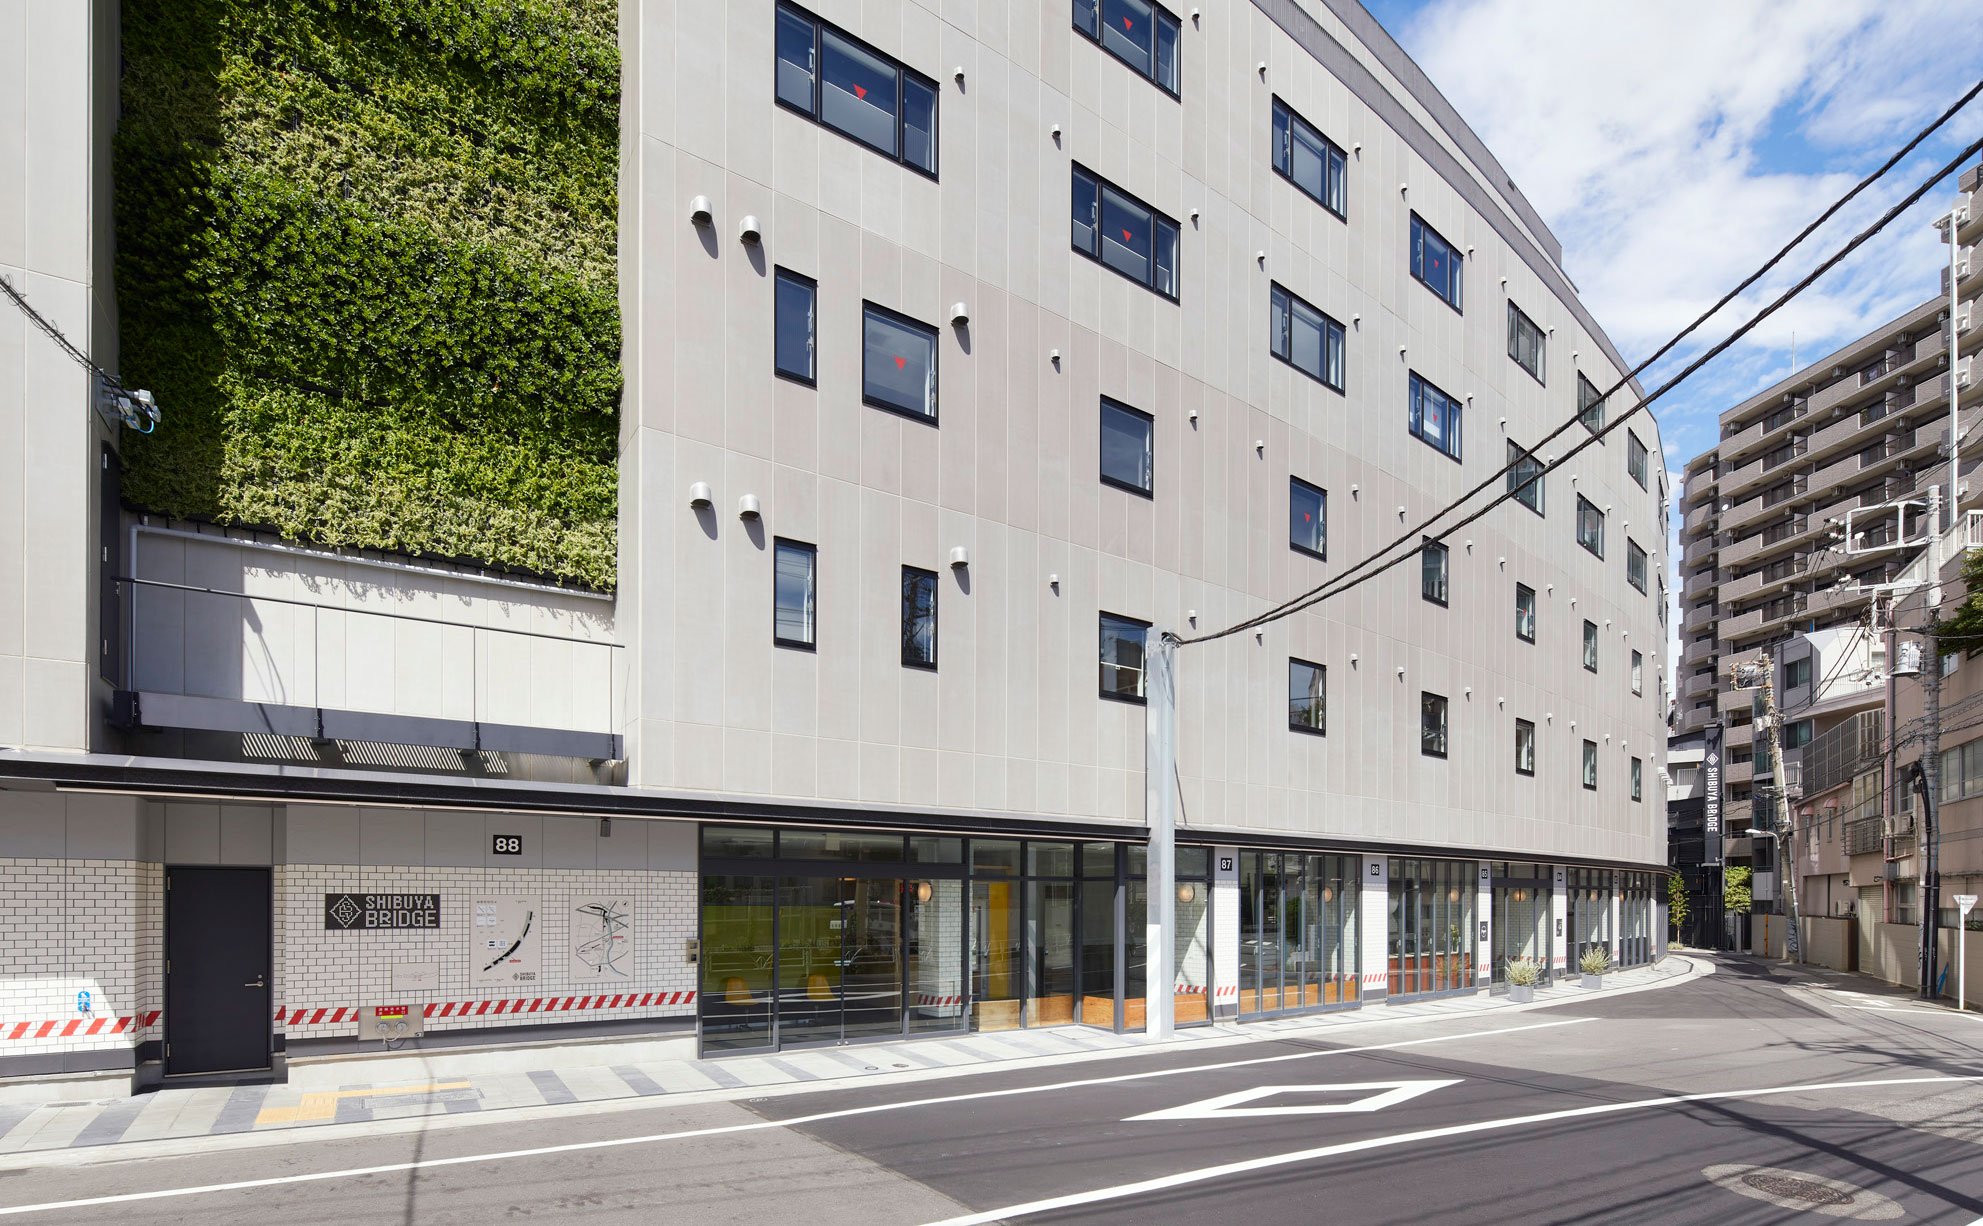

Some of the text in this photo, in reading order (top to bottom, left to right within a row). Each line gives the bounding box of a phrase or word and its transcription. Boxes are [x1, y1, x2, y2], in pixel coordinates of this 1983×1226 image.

[1707, 767, 1718, 832] SHIBUYA BRIDGE
[496, 837, 519, 852] 88
[1221, 859, 1231, 870] 87
[1371, 865, 1379, 874] 86
[365, 895, 434, 909] SHIBUYA
[365, 910, 437, 927] BRIDGE
